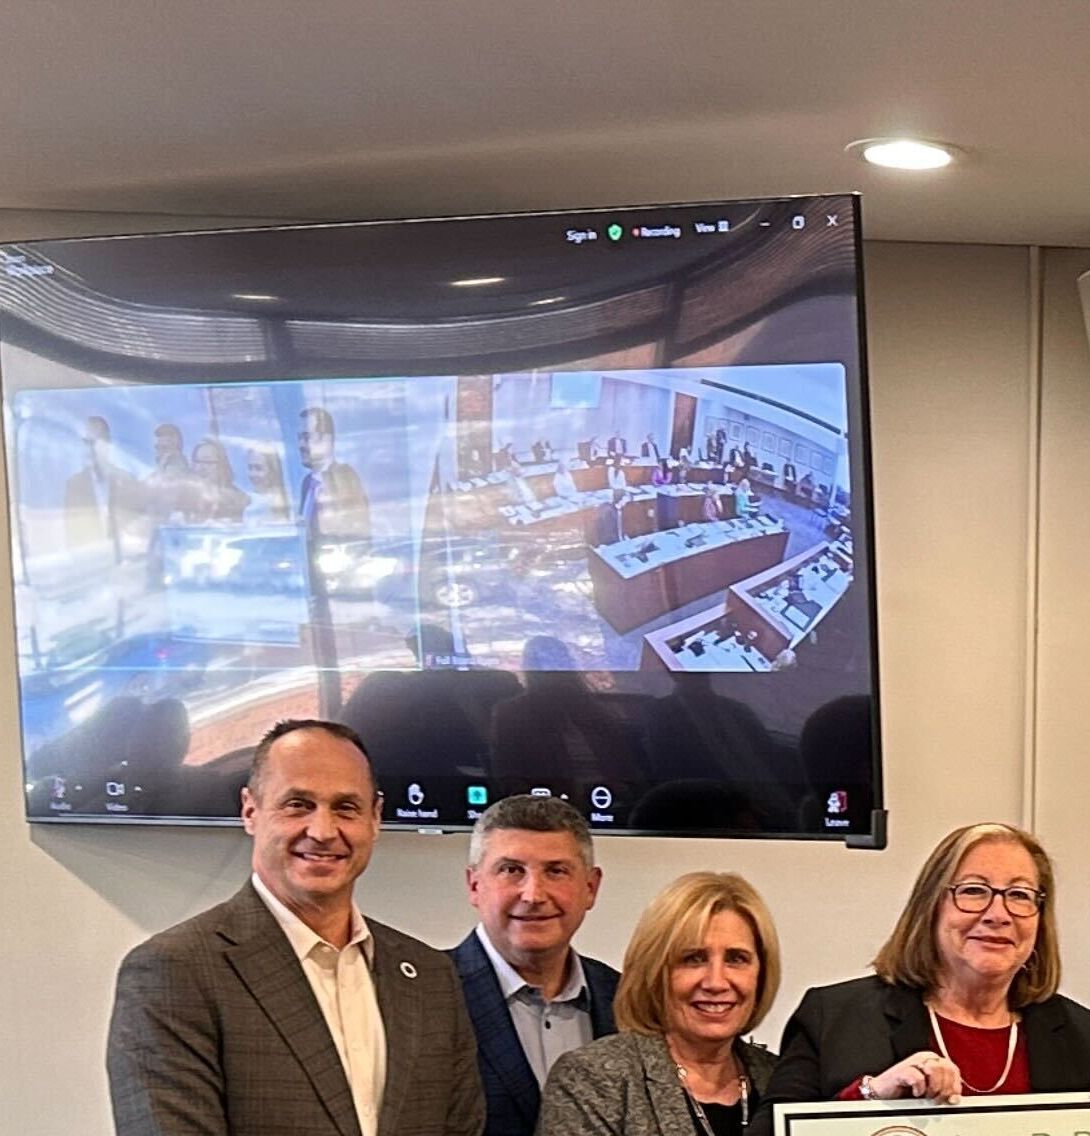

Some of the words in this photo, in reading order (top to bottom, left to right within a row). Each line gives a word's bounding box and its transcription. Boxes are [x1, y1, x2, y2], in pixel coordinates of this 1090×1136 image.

[641, 225, 682, 238] Recording
[695, 222, 716, 233] View
[590, 812, 614, 823] More
[824, 817, 850, 827] Leave
